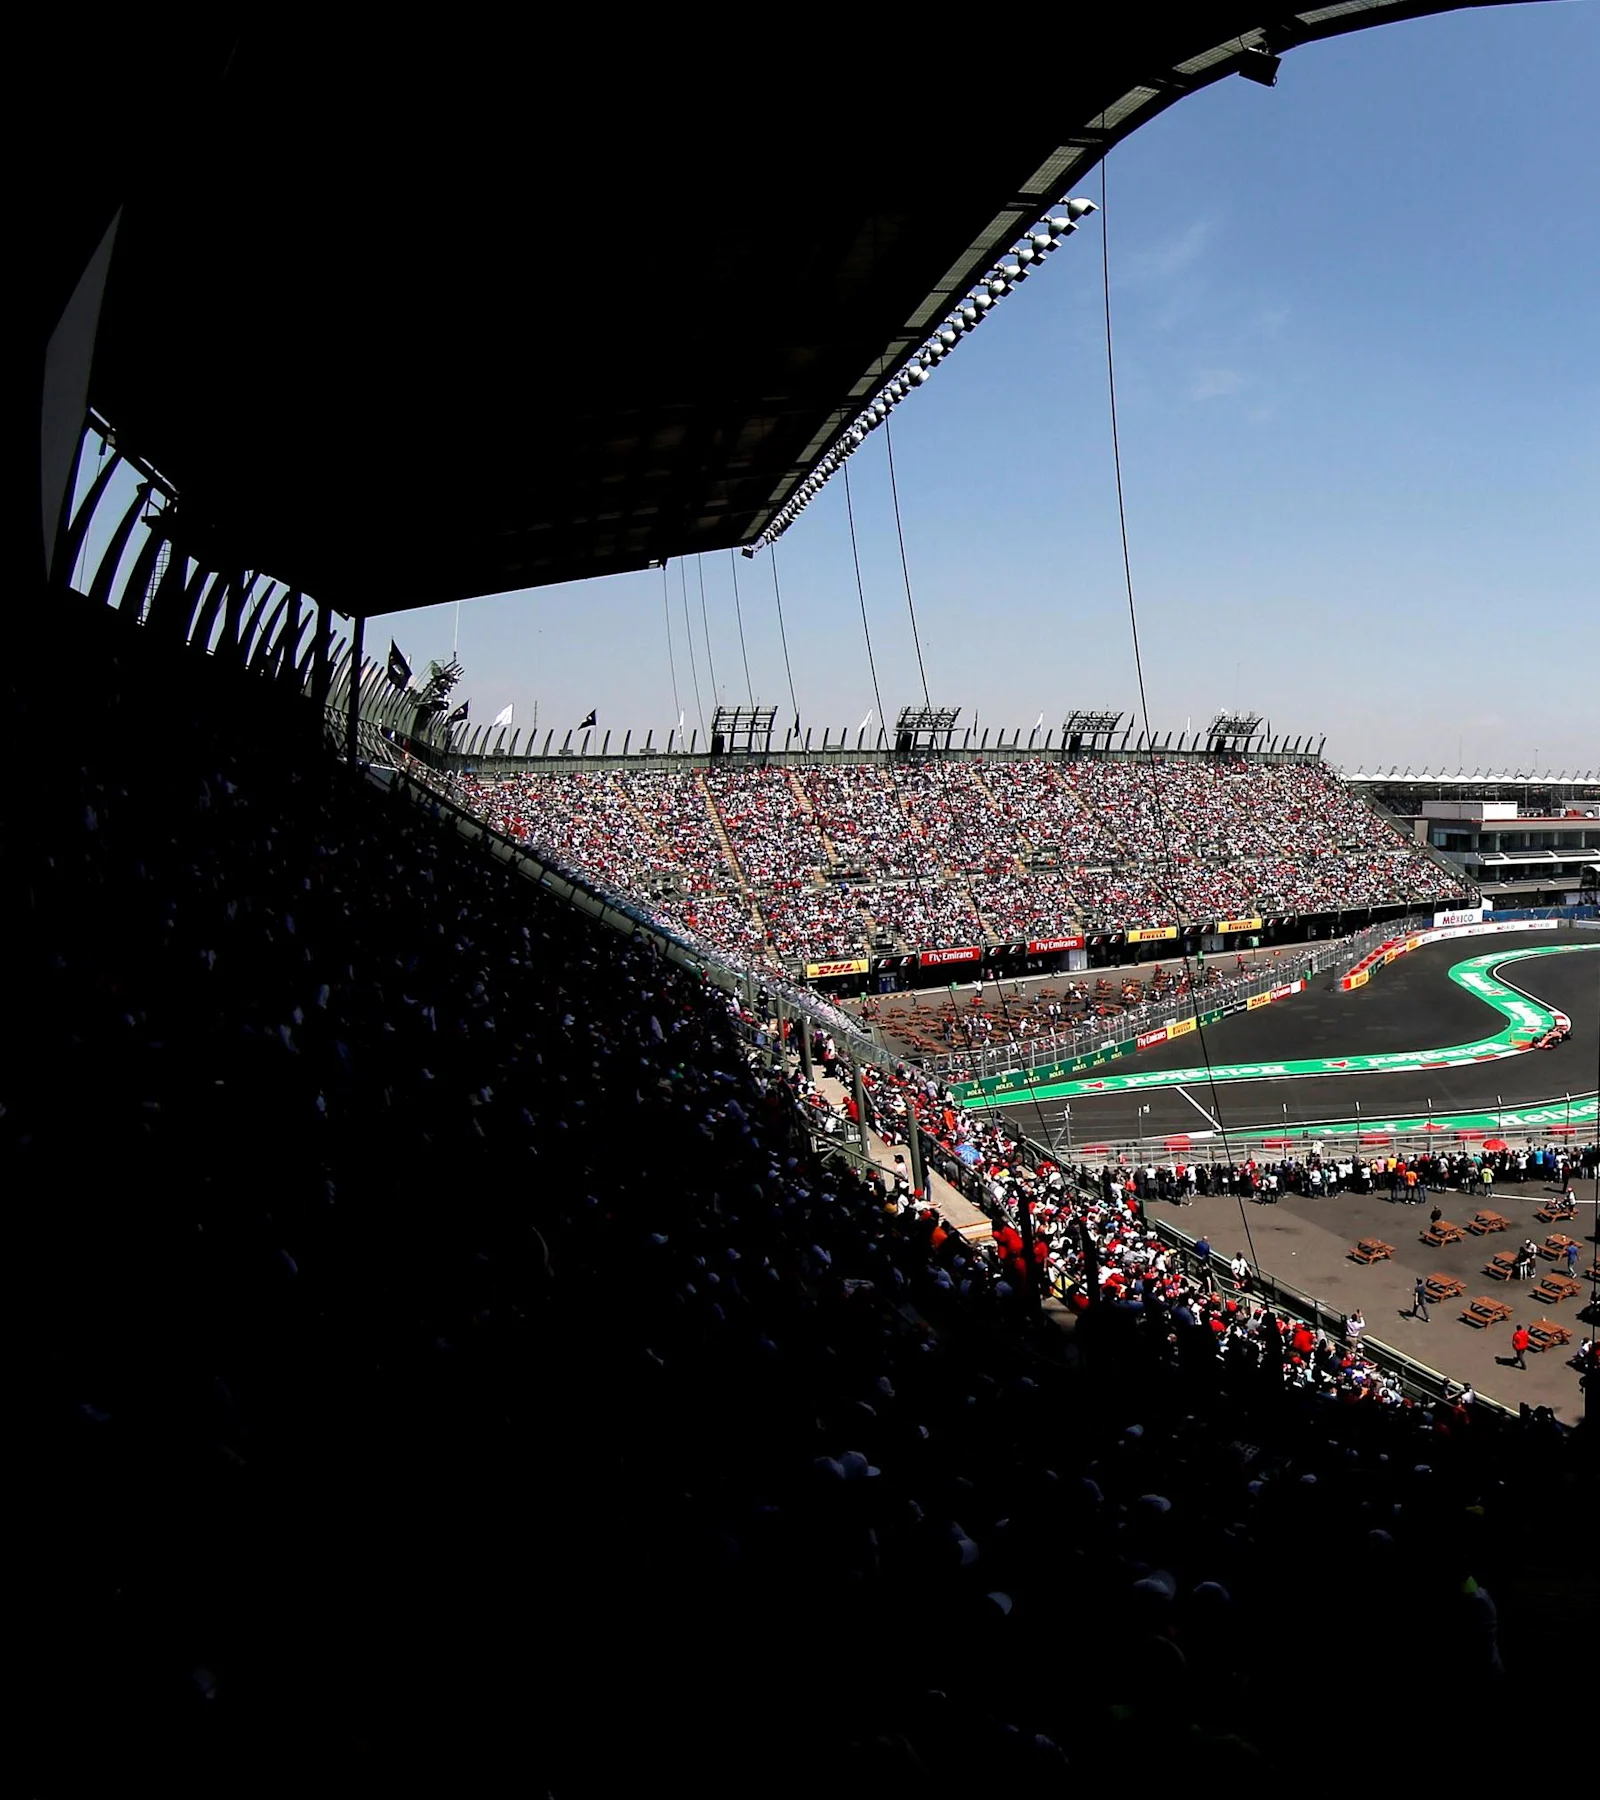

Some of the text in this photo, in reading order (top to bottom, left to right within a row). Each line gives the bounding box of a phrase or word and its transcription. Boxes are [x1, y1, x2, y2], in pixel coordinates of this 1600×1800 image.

[1228, 922, 1252, 931] PIRELLI
[1140, 930, 1166, 940] PIRELLI
[1036, 940, 1077, 950] Fly Emirates
[929, 951, 973, 962] Fly Emirates
[818, 963, 854, 975] DHL
[1050, 1070, 1064, 1078] ROLEX
[1023, 1076, 1040, 1084] ROLEX
